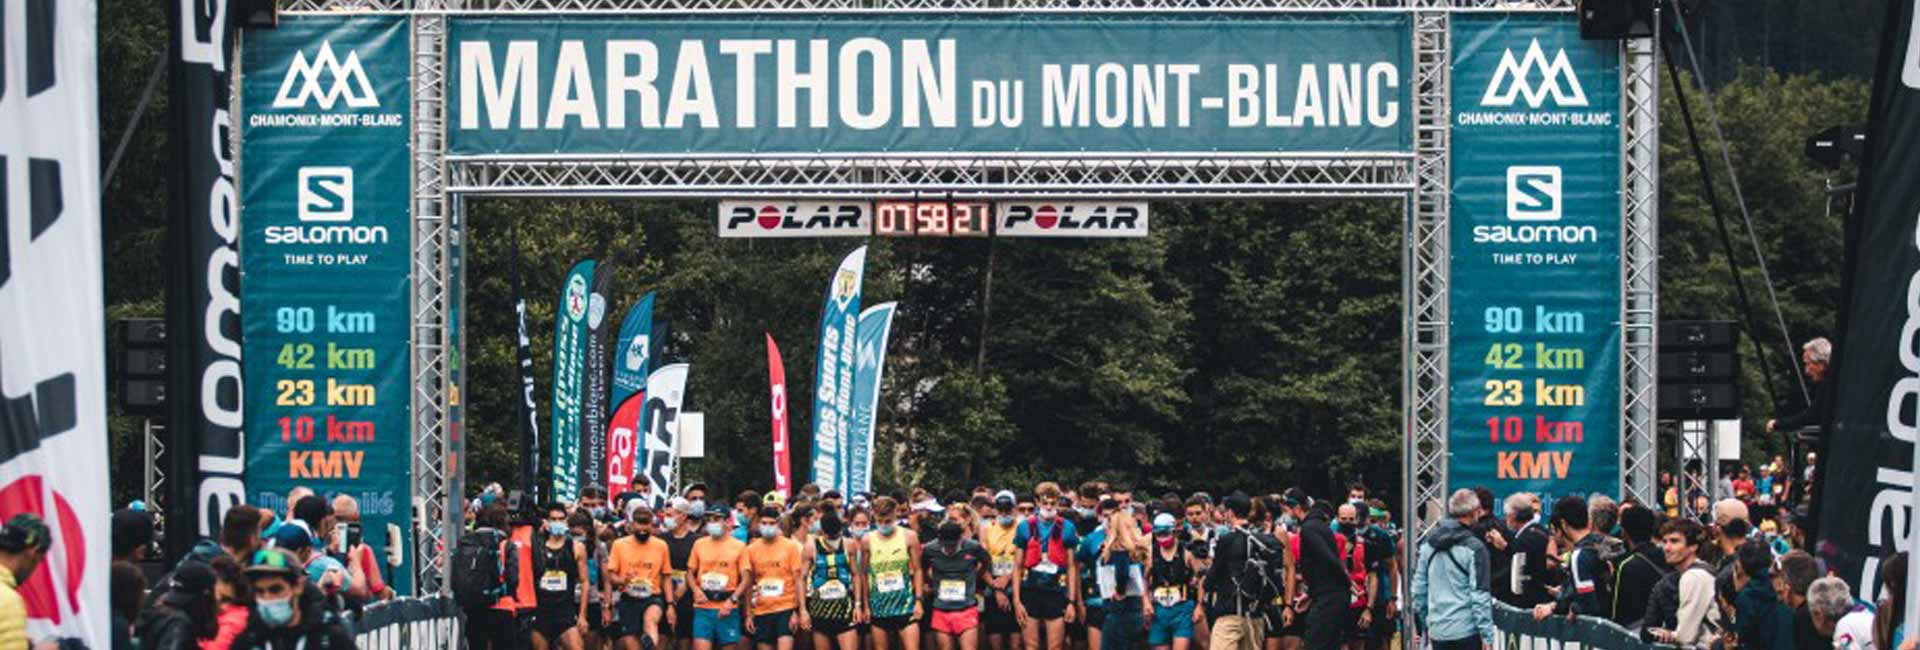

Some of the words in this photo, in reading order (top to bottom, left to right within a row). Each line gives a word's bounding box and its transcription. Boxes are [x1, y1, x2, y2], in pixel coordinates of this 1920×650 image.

[459, 37, 957, 131] MARATHON
[972, 80, 1024, 128] DU
[1042, 62, 1400, 129] MONT-BLANC
[727, 205, 864, 230] POLAR
[1003, 205, 1139, 230] POLAR
[284, 254, 314, 266] TIME
[320, 254, 336, 266] TO
[338, 254, 369, 266] PLAY
[1493, 253, 1523, 265] TIME
[1527, 253, 1544, 265] TO
[1546, 253, 1577, 265] PLAY
[277, 307, 315, 334] 90
[328, 305, 376, 333] km
[1485, 307, 1523, 334] 90
[1536, 305, 1584, 333] km
[277, 344, 315, 371] 42
[328, 342, 376, 370] km
[818, 324, 839, 405] Sports
[1485, 344, 1523, 371] 42
[1536, 342, 1584, 370] km
[277, 380, 315, 407] 23
[328, 378, 376, 406] km
[1485, 380, 1523, 407] 23
[1536, 378, 1584, 406] km
[277, 416, 315, 443] 10
[328, 414, 376, 442] km
[815, 404, 837, 451] des
[1485, 416, 1523, 443] 10
[1536, 414, 1584, 442] km
[290, 451, 364, 479] KMV
[1498, 451, 1572, 479] KMV
